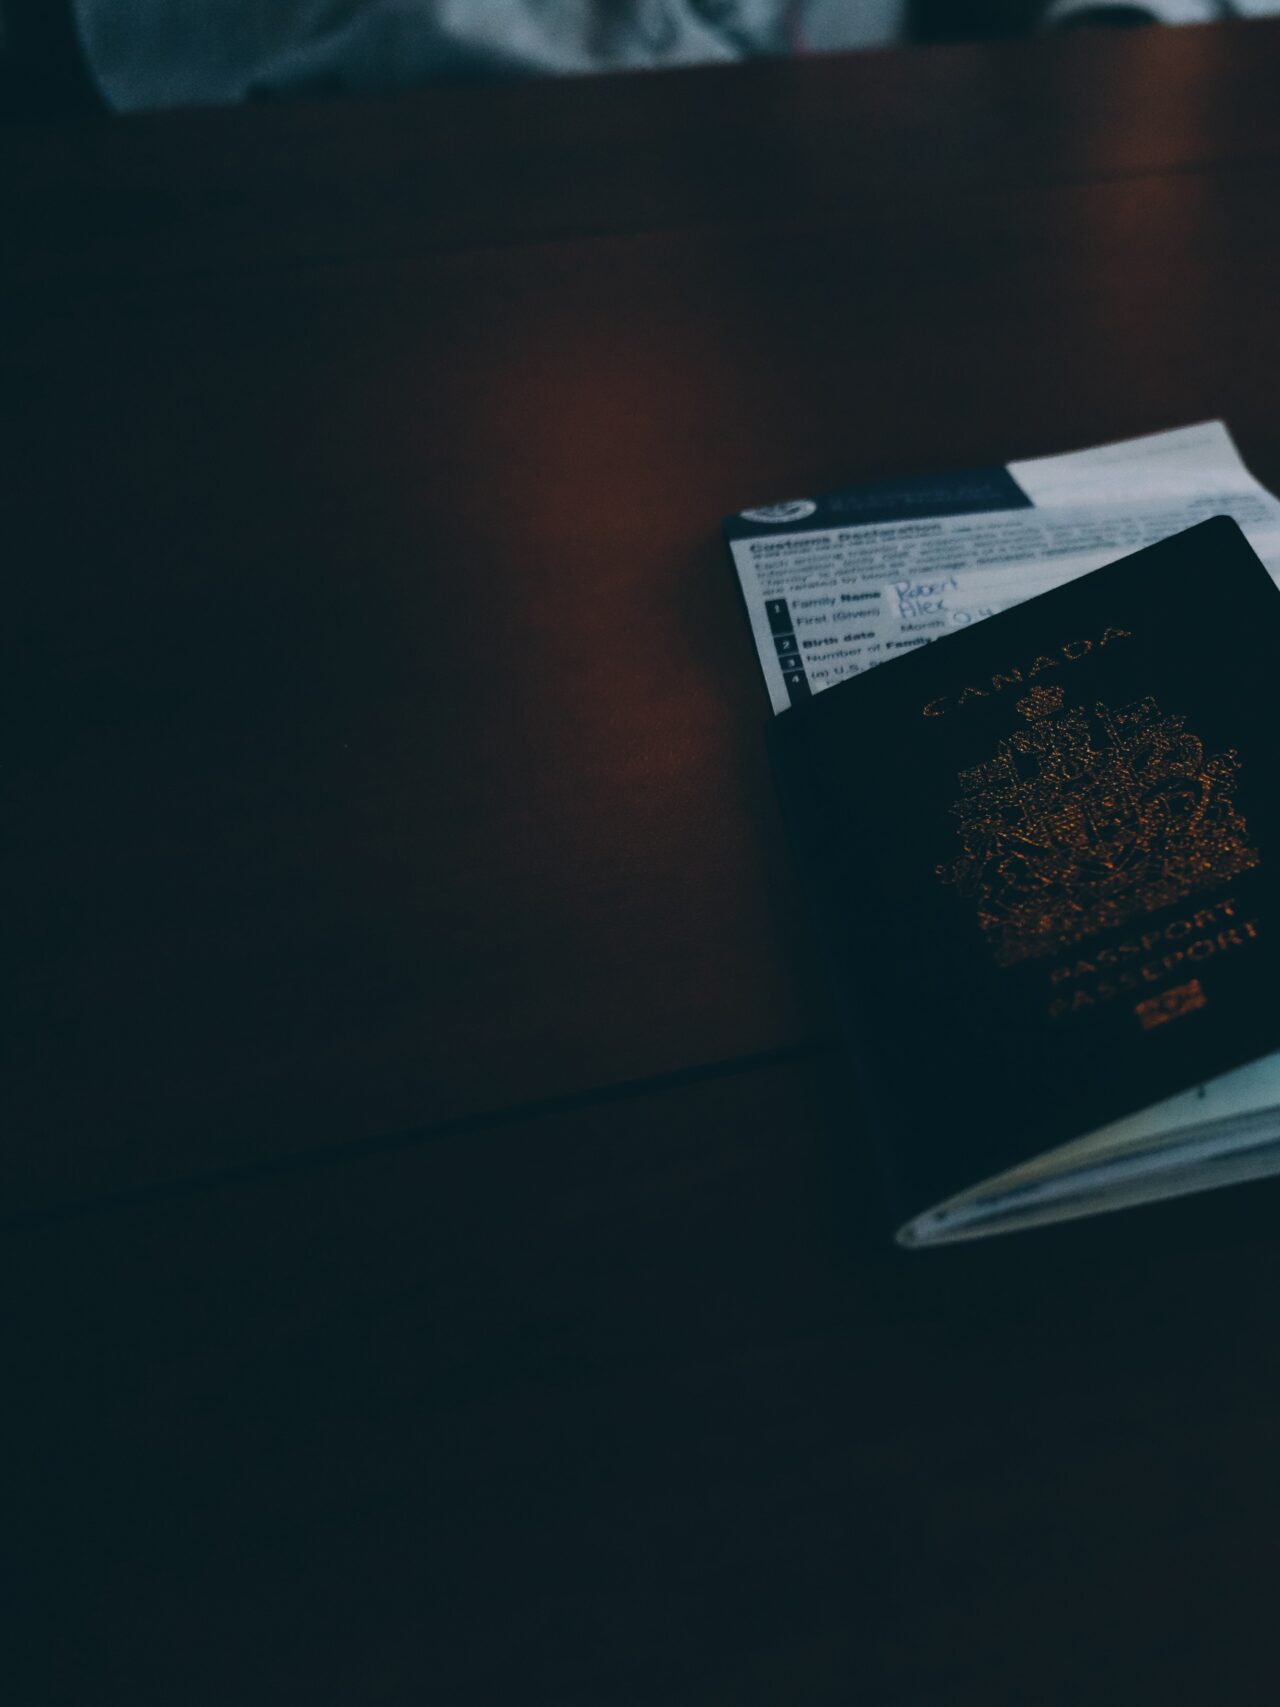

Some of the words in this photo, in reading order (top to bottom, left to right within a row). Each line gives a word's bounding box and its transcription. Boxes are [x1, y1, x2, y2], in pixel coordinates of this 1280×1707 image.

[750, 537, 832, 552] Customs
[838, 524, 941, 540] Declaration
[774, 603, 781, 614] 1
[792, 597, 835, 609] Family
[841, 592, 881, 603] Name
[899, 599, 948, 618] Alex
[796, 613, 827, 626] First
[832, 608, 881, 622] (Given)
[900, 620, 945, 632] Month
[782, 641, 791, 651] 2
[802, 637, 839, 649] Birth
[843, 630, 876, 642] date
[806, 648, 861, 661] Number
[867, 643, 880, 652] of
[886, 637, 932, 650] Family
[811, 669, 829, 680] (a)
[922, 626, 1134, 718] CANADA
[1050, 897, 1237, 985] PASSPORT
[1047, 917, 1261, 1017] PASSEPORT
